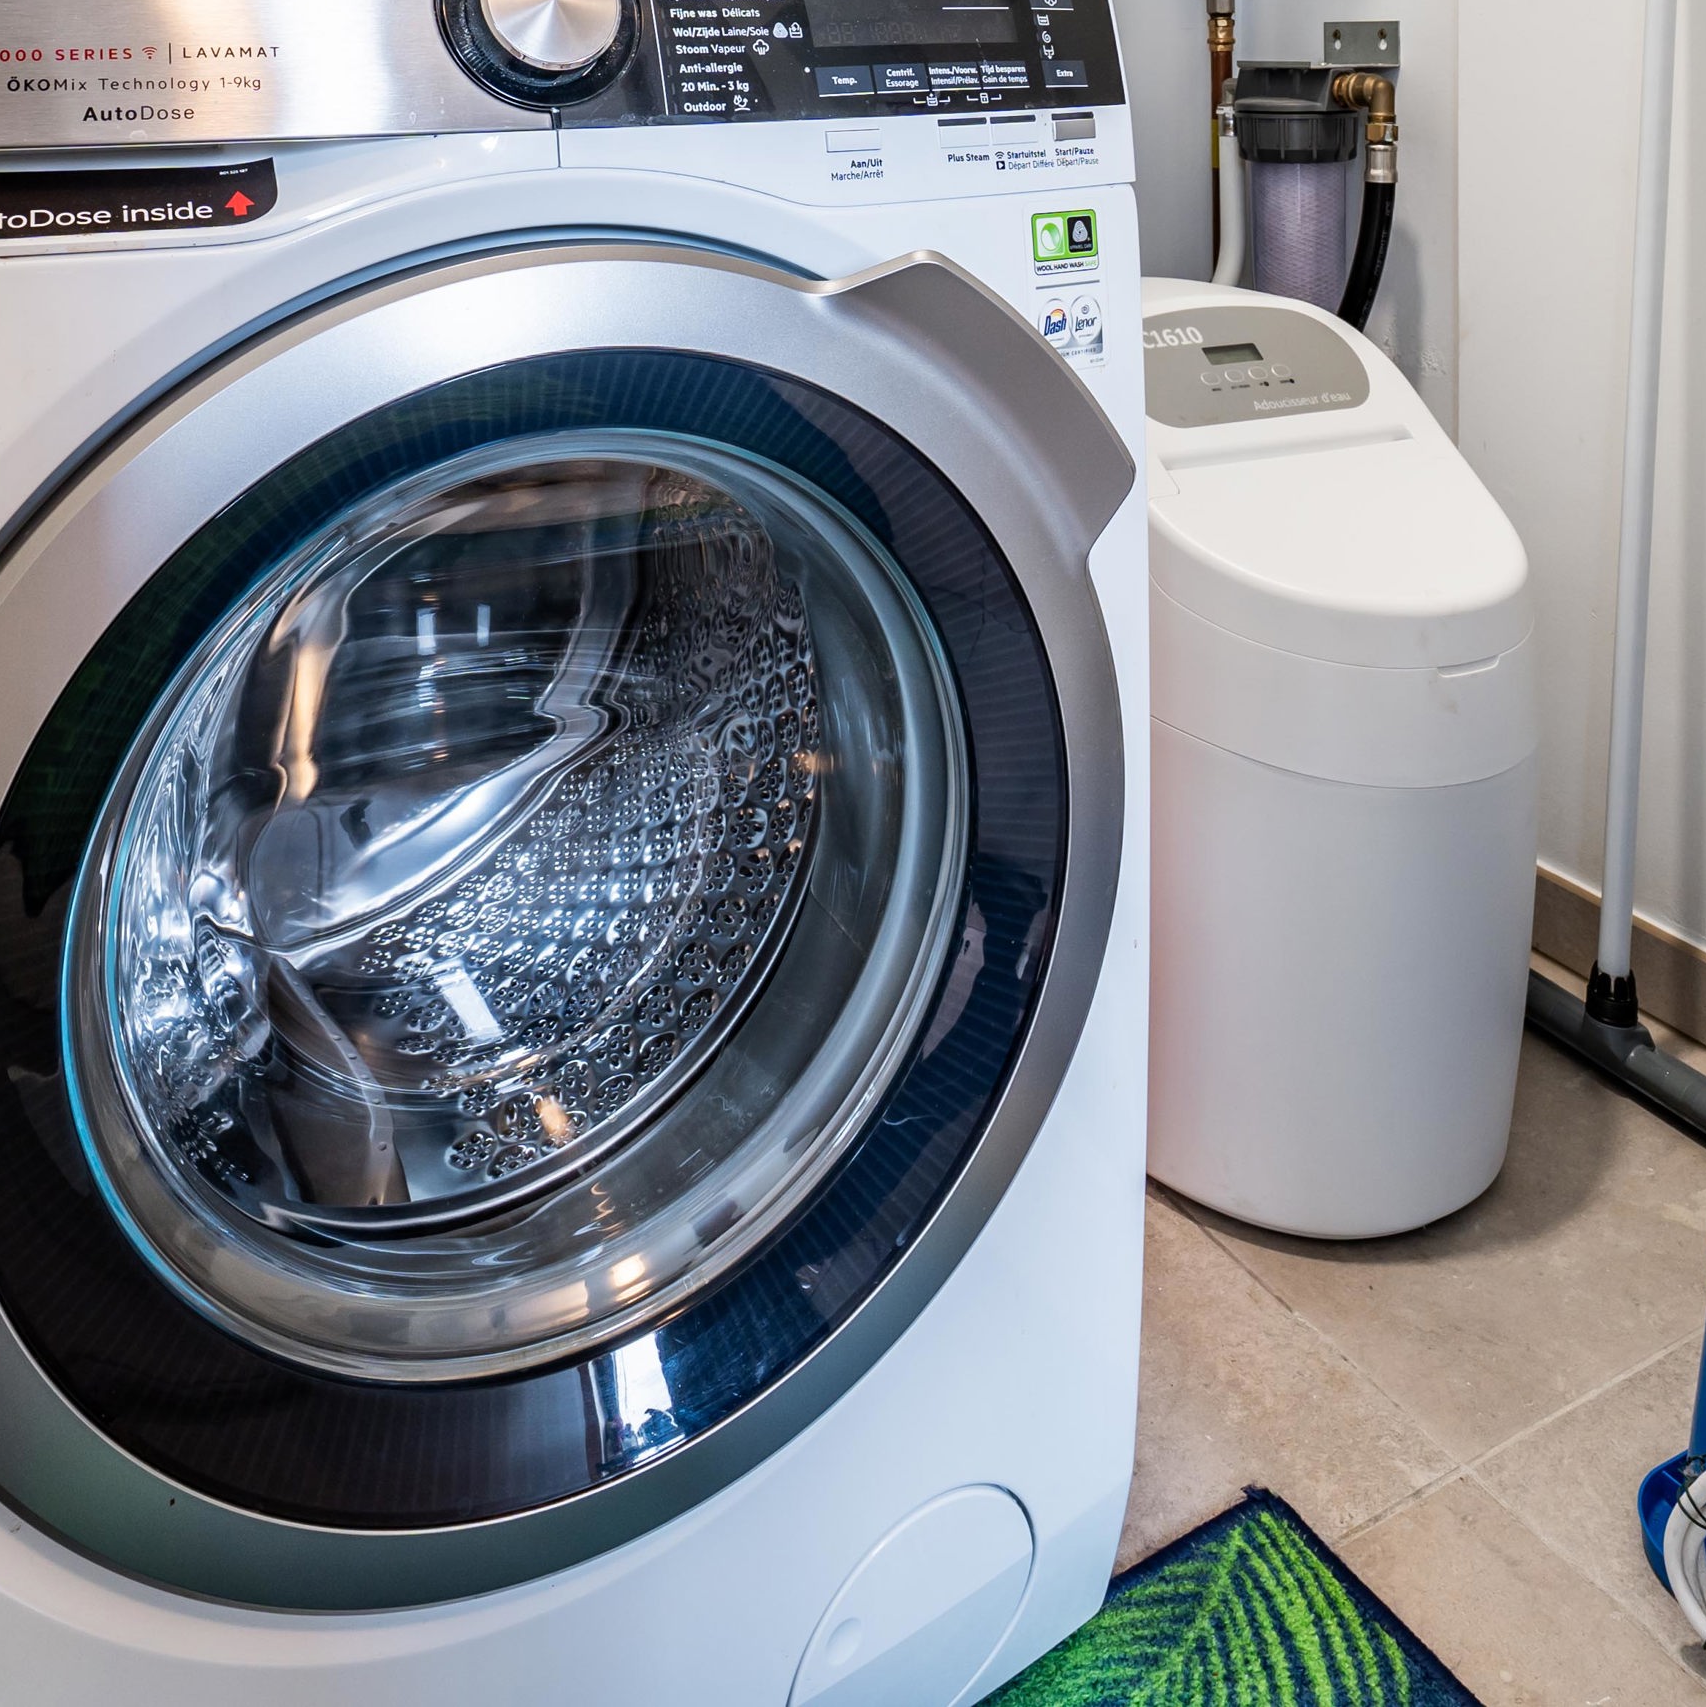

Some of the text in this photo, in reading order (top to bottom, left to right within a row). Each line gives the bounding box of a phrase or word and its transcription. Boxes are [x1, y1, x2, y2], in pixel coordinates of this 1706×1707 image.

[669, 7, 761, 20] Fijne was Délicats
[672, 26, 770, 39] Wol/Zijde Laine/Soie
[54, 46, 134, 62] SERIES
[182, 44, 281, 60] LAVAMAT
[675, 43, 746, 56] Stoom Vapeur
[679, 62, 744, 75] Anti-allergie
[886, 67, 916, 77] Centrif.
[980, 64, 1027, 76] Tijd besparen
[1055, 68, 1074, 78] Extra
[6, 74, 262, 96] ÖKOMix Technology 1-9kg
[681, 81, 696, 93] 20
[697, 80, 720, 92] Min.
[727, 80, 735, 91] 3
[736, 79, 750, 93] kg
[831, 75, 859, 87] Temp.
[885, 78, 920, 89] Essorage
[981, 74, 1029, 85] Gain de temps
[82, 103, 196, 123] AutoDose
[683, 101, 727, 113] Outdoor
[947, 152, 991, 164] Plus Steam
[1006, 149, 1047, 160] Startuitstel
[1054, 146, 1095, 157] Start/Pauze
[850, 157, 884, 170] Aan/Uit
[1008, 160, 1032, 171] Départ
[830, 169, 885, 182] Marche/Arrêt
[121, 201, 214, 225] inside
[1036, 264, 1054, 272] WOOL
[1053, 262, 1069, 270] HAND
[1069, 261, 1085, 269] WASH
[1043, 311, 1068, 337] Dash
[1074, 315, 1098, 334] Lenor
[1253, 391, 1353, 411] Adoucisseur d'eau
